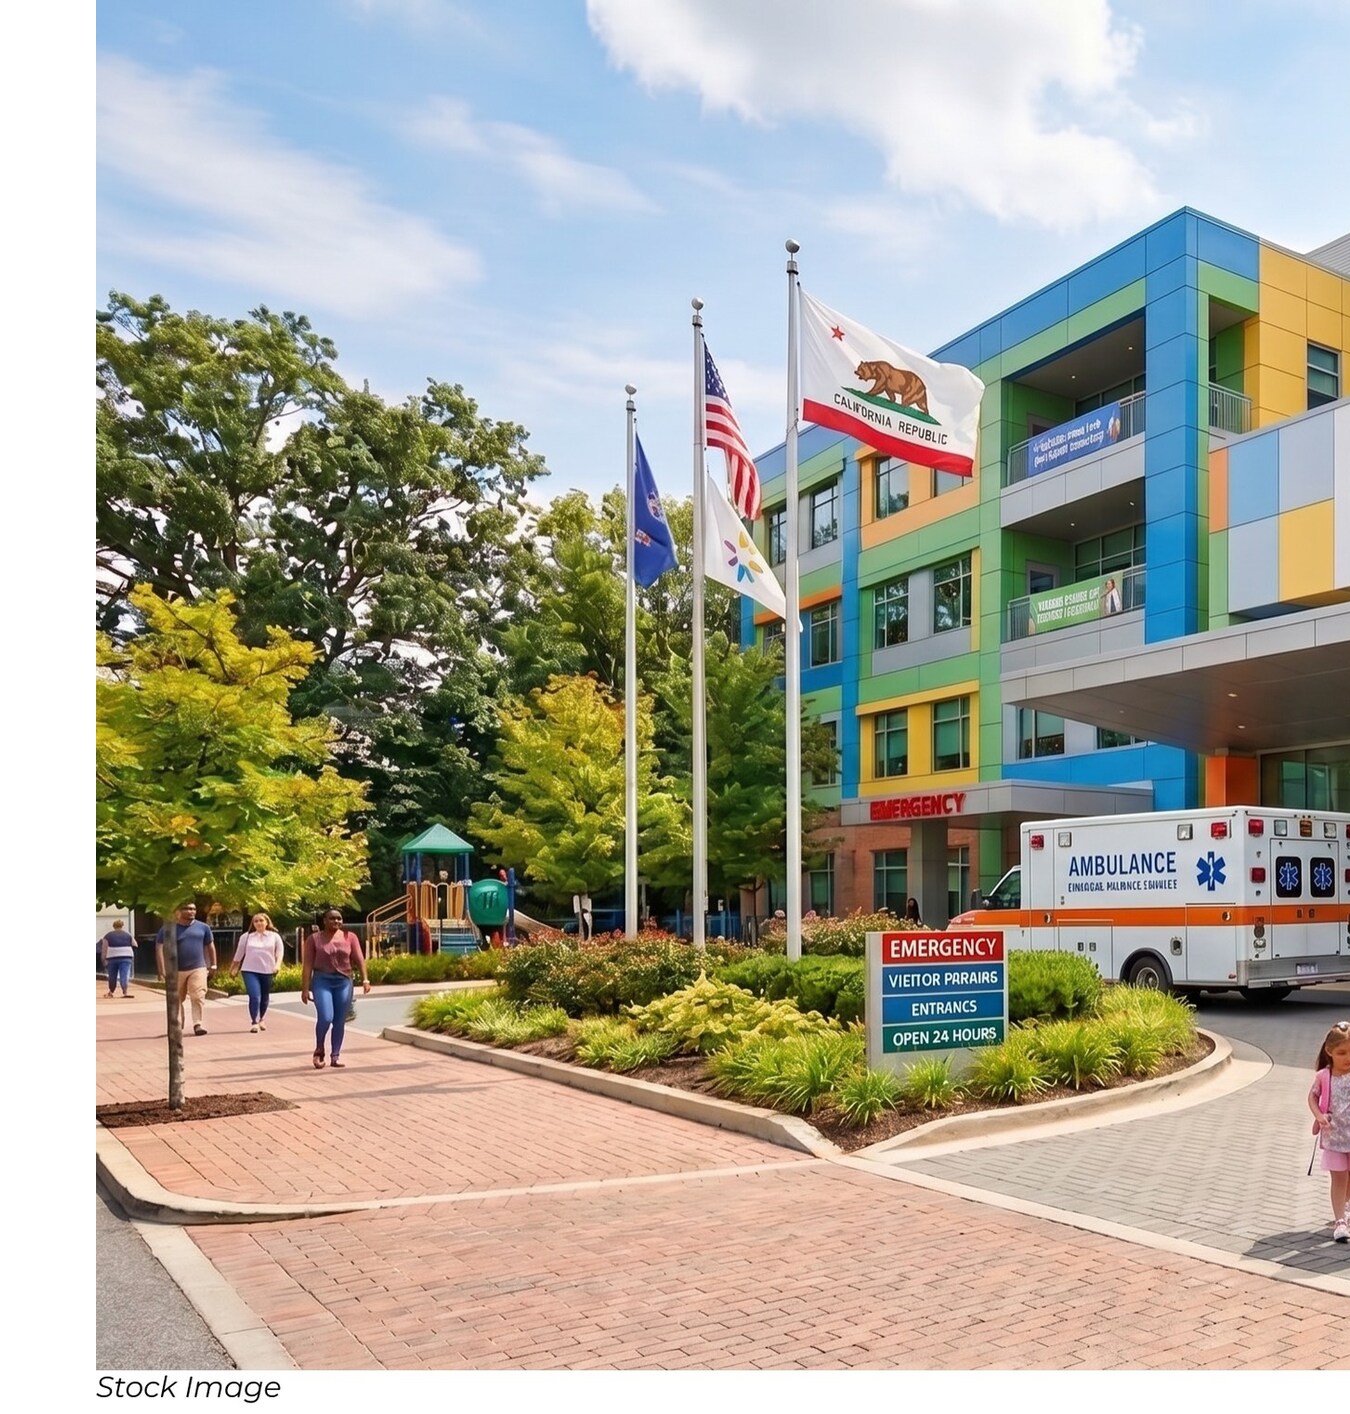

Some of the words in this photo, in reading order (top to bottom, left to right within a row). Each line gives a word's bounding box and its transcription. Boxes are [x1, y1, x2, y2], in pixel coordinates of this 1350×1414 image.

[834, 393, 892, 428] CALIFORNIA
[898, 421, 948, 445] REPUBLIC
[870, 792, 966, 821] EMERGENCY
[1069, 851, 1177, 876] AMBULANCE
[890, 937, 997, 958] EMERGENCY
[912, 1000, 977, 1017] ENTRANCS
[893, 1031, 930, 1046] OPEN
[932, 1030, 950, 1044] 24
[953, 1026, 997, 1042] HOURS
